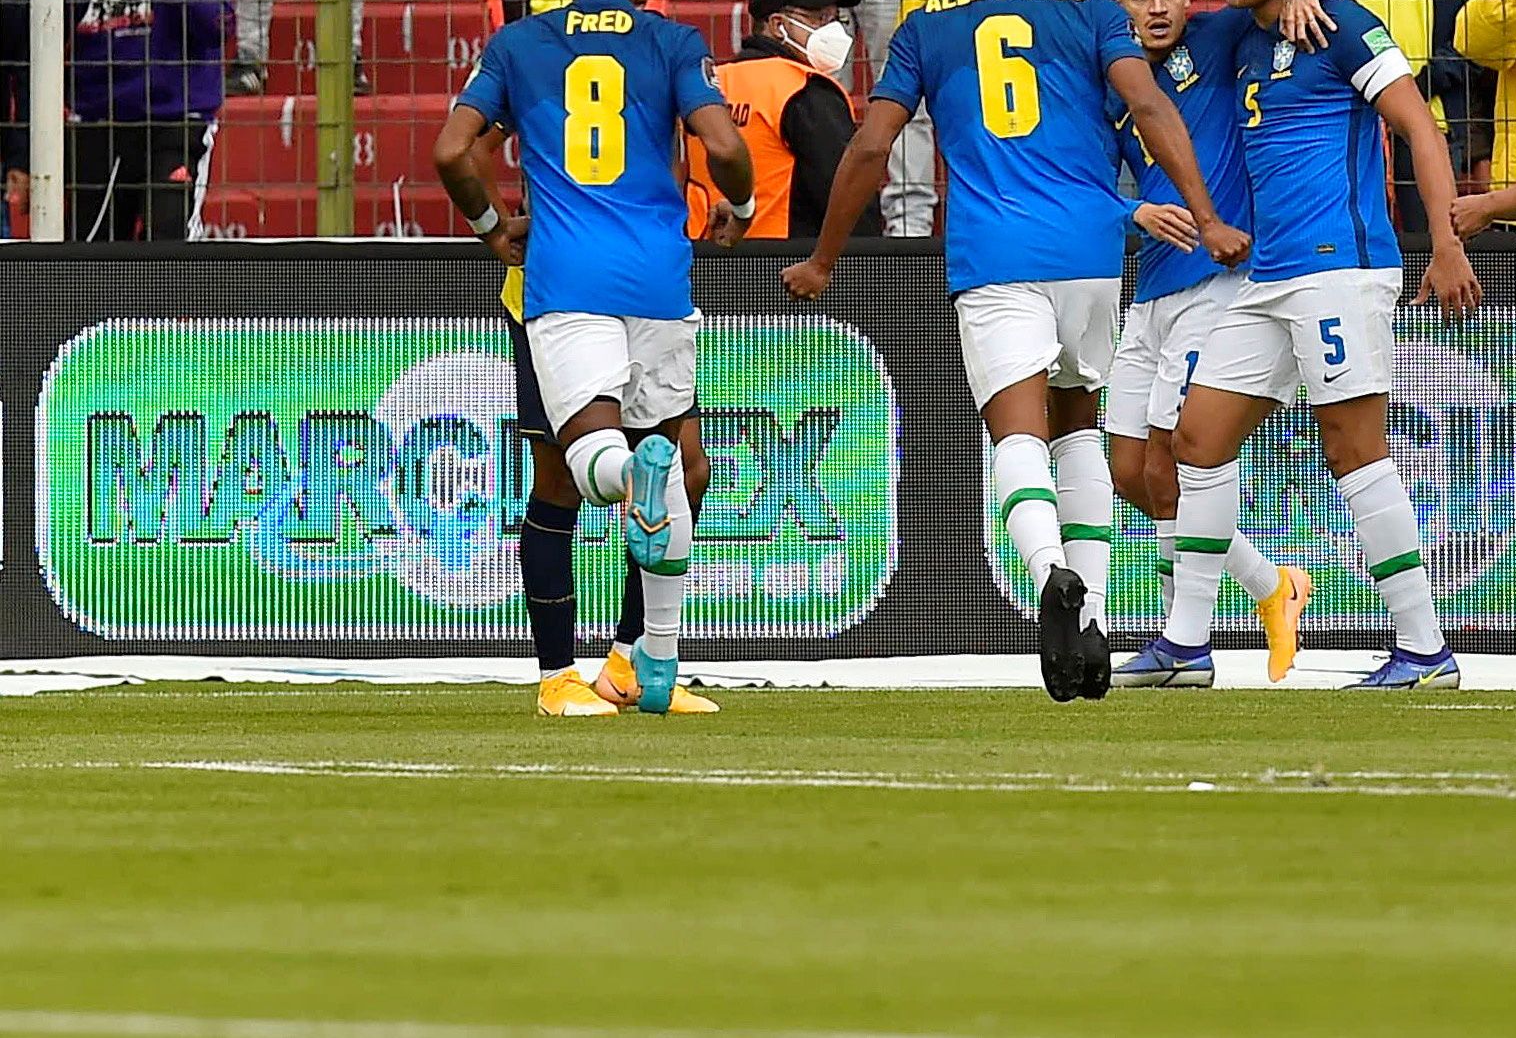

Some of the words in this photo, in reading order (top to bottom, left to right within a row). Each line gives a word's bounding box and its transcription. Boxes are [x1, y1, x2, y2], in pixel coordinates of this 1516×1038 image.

[566, 10, 633, 35] FRED
[974, 14, 1042, 139] 6
[564, 54, 626, 186] 8
[1244, 81, 1262, 128] 5
[1319, 316, 1346, 366] 5
